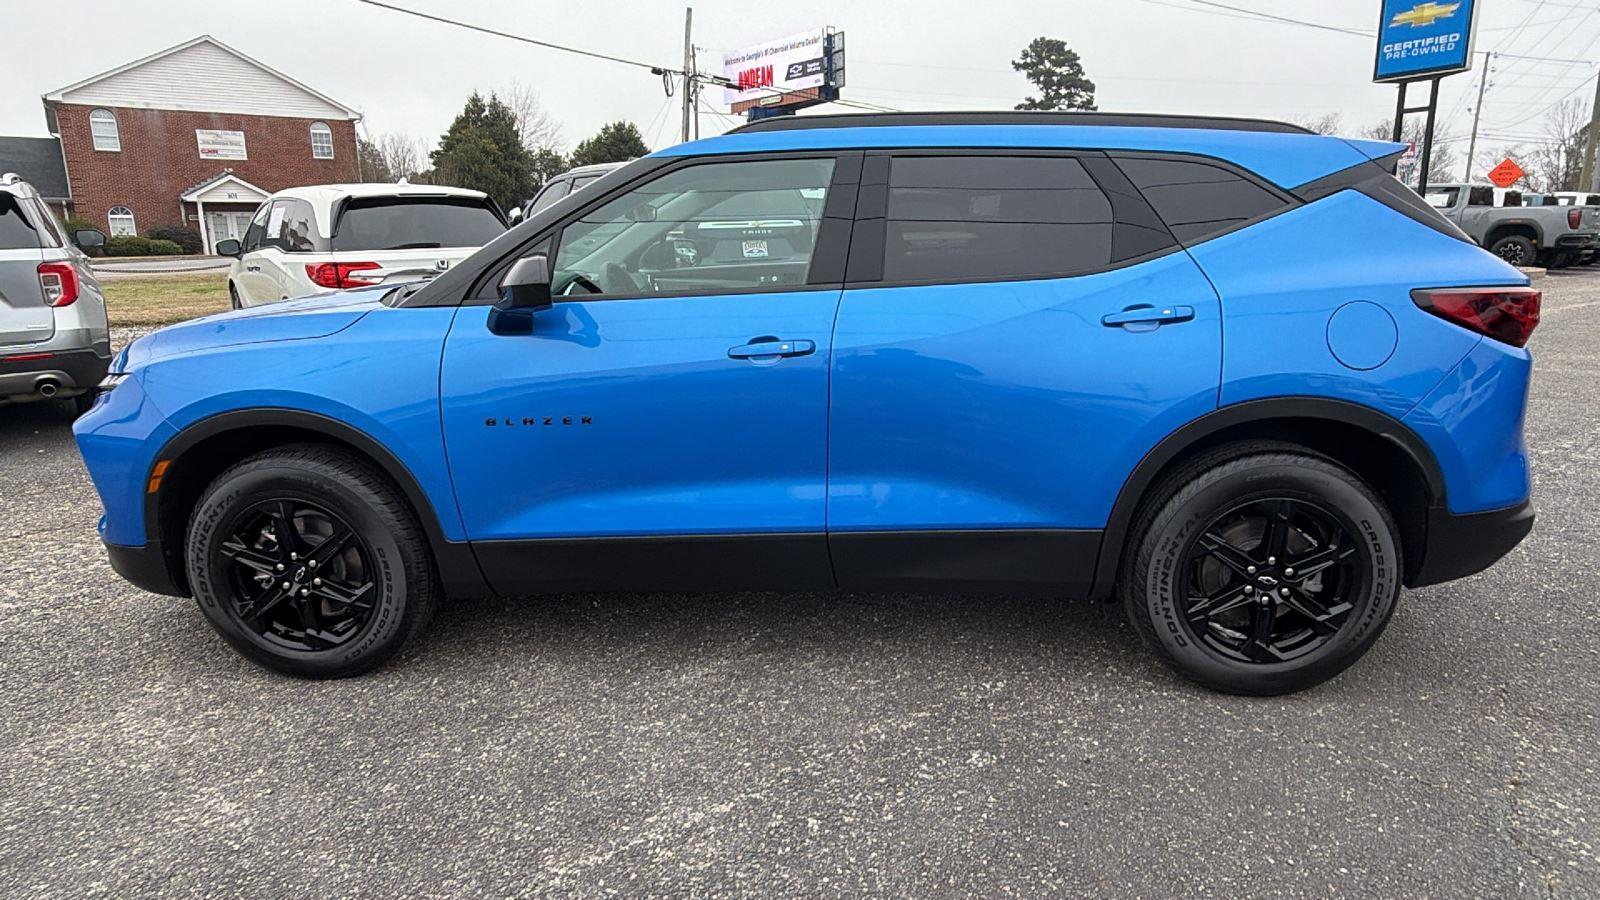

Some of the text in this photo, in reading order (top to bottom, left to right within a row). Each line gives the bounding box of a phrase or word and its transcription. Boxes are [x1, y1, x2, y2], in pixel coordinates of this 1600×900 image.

[725, 56, 741, 66] Welcome
[746, 49, 764, 62] Georgia's
[769, 44, 789, 56] Chevrolet
[789, 40, 805, 50] Volume
[1383, 33, 1460, 53] CERTIFIED
[1386, 42, 1455, 60] PRE-OWNED
[738, 64, 774, 93] ANDEAN
[485, 416, 593, 427] BLAZER
